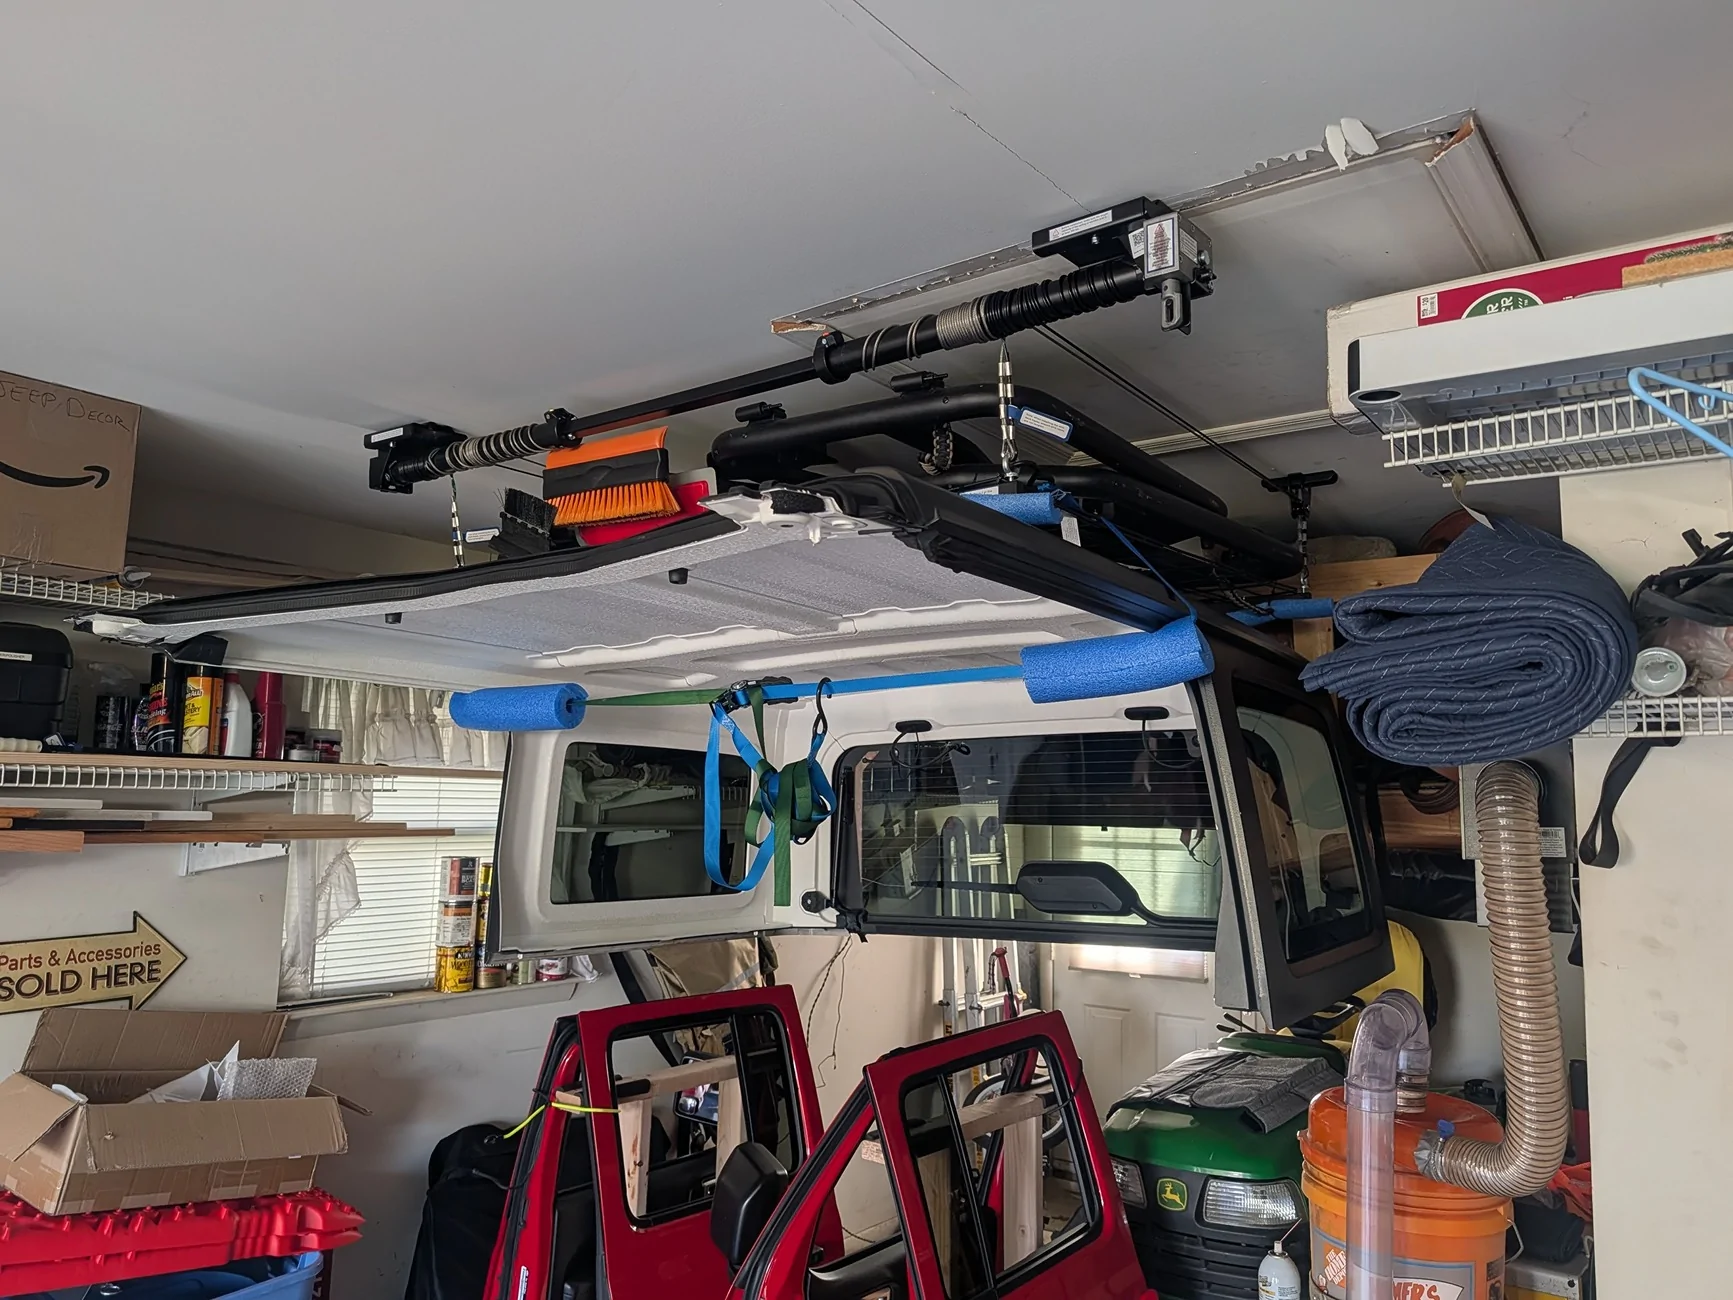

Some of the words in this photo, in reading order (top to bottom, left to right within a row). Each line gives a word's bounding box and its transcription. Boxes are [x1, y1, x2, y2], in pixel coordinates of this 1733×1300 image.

[0, 954, 43, 971] Parts
[48, 950, 61, 967] &
[65, 941, 161, 965] Accessories
[0, 969, 82, 1001] SOLD
[91, 960, 161, 991] HERE
[1392, 1281, 1441, 1300] MER'S
